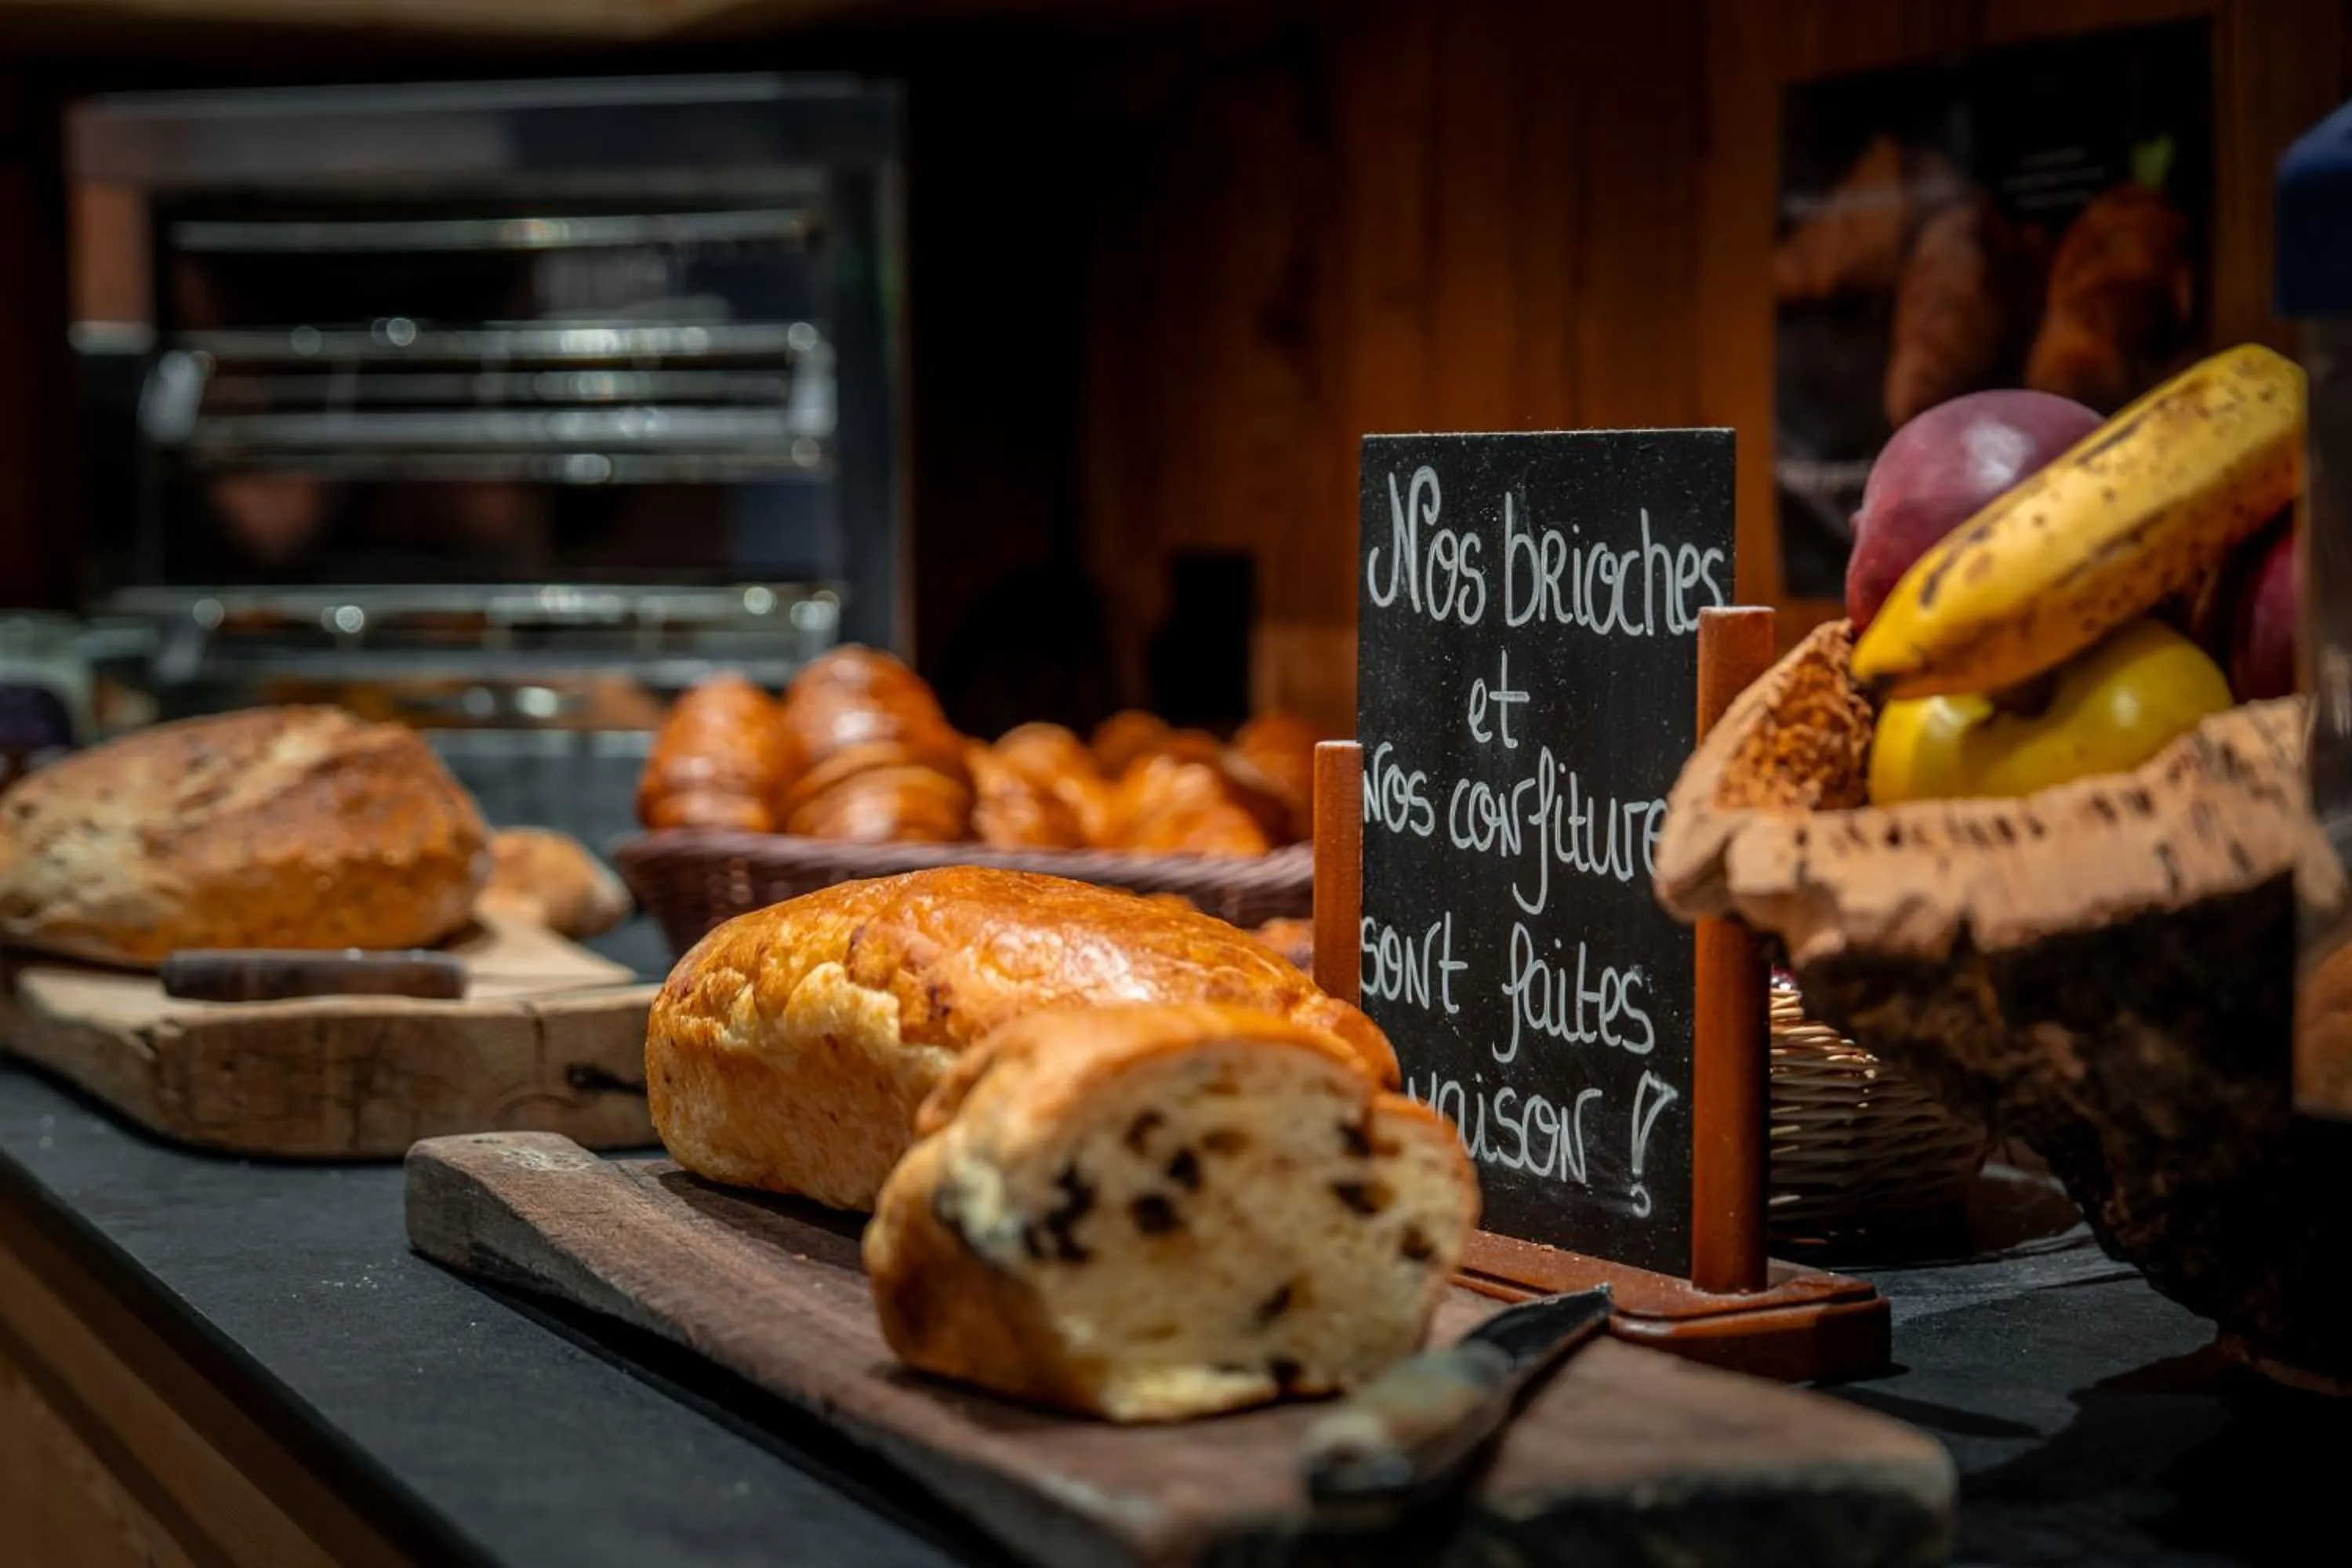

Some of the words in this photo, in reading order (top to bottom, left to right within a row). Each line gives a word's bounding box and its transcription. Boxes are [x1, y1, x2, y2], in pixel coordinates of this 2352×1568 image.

[1367, 466, 1487, 626] Nos
[1468, 649, 1531, 749] et
[1449, 746, 1668, 916] confiture
[1360, 911, 1468, 1014] sont
[1492, 922, 1655, 1063] faites
